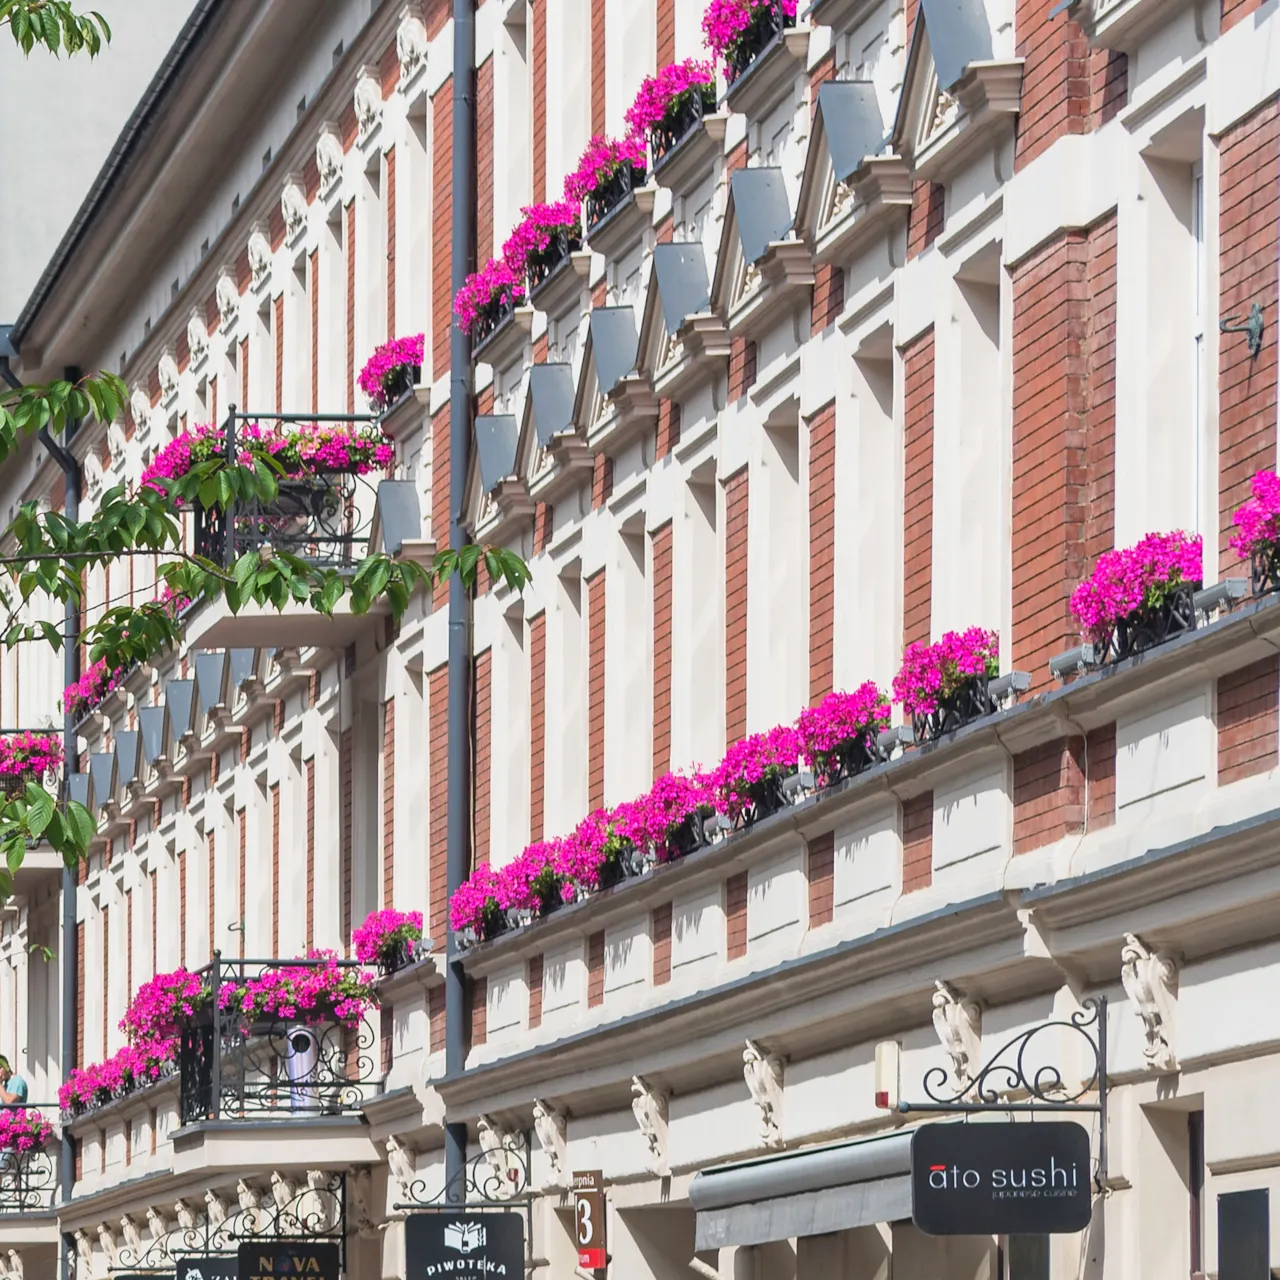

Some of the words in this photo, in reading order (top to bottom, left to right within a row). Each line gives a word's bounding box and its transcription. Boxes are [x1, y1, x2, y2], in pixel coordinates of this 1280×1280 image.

[992, 1156, 1078, 1188] sushi
[576, 1198, 594, 1245] 3
[426, 1258, 507, 1277] PIWOTEKA
